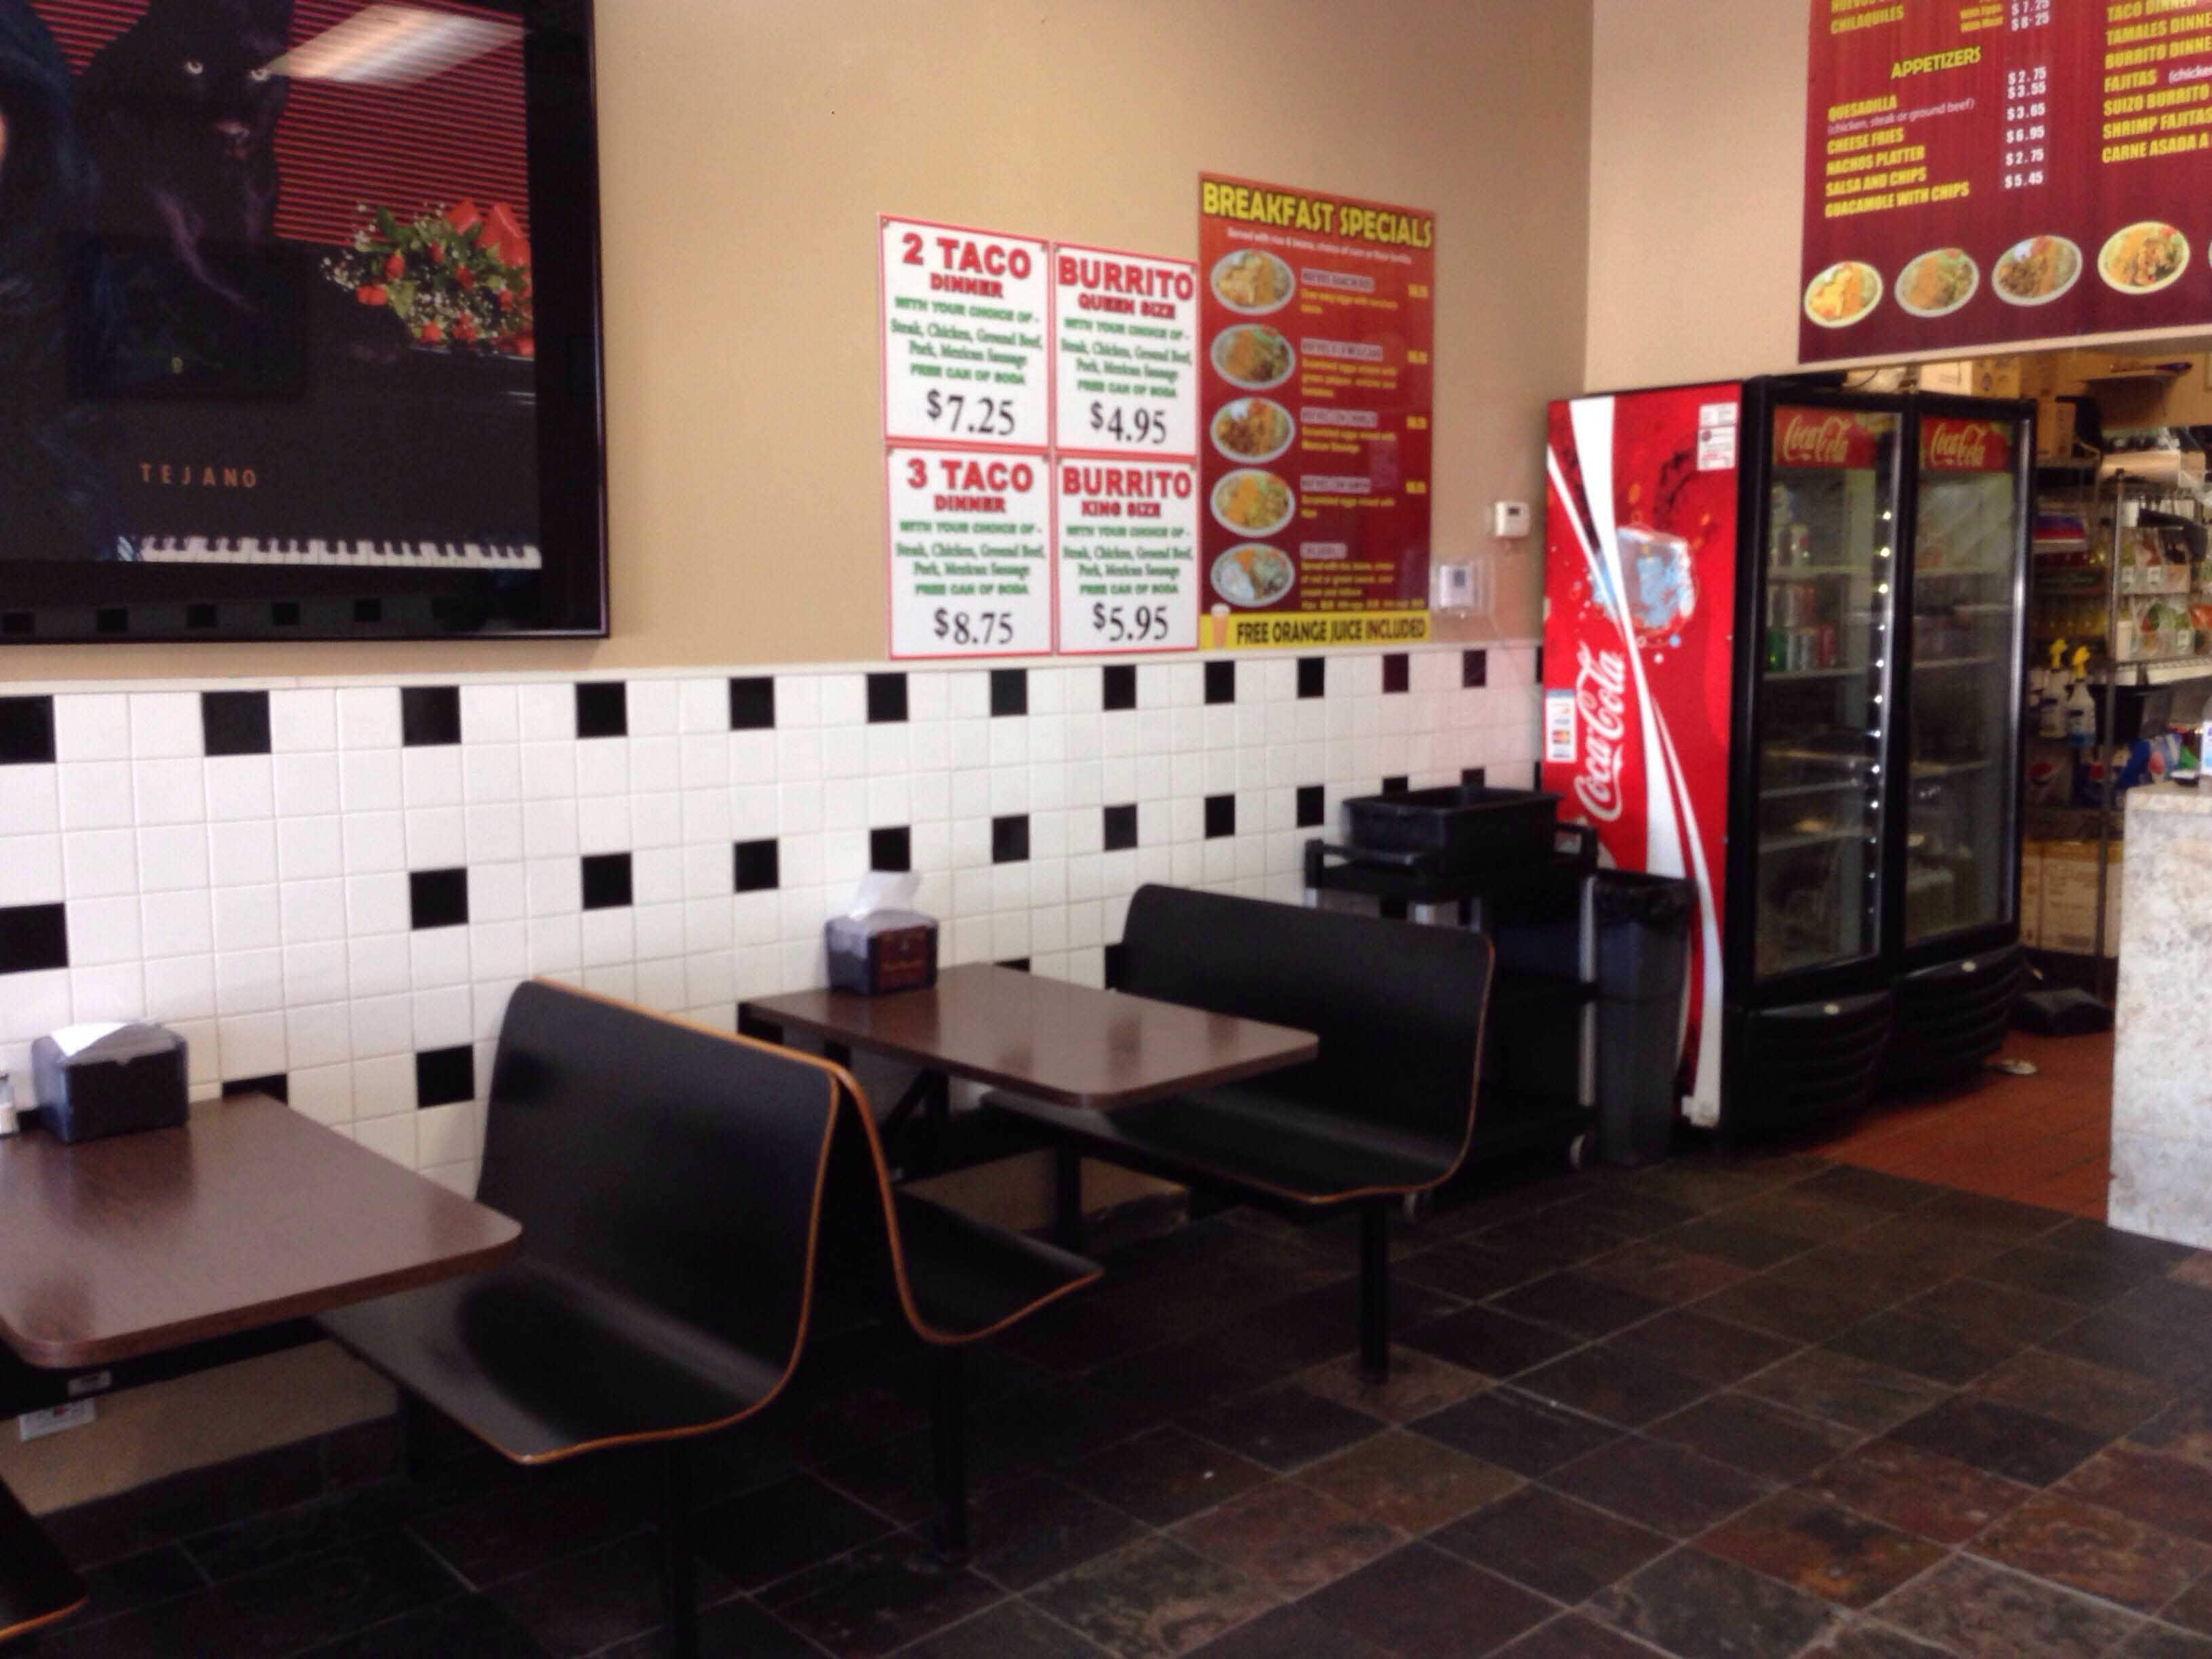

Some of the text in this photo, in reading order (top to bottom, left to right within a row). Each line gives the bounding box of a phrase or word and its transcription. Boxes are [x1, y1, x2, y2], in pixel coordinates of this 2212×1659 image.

[2106, 2, 2143, 23] TACO
[2105, 20, 2167, 47] TAMALES
[1891, 46, 1982, 79] APPETIZERS
[2104, 43, 2167, 70] BURRITO
[2104, 68, 2157, 94] FAJITAS
[1828, 95, 1897, 123] QUESADILLA
[2103, 83, 2210, 117] SUIZO BURRITO
[1826, 126, 1905, 155] CHEESE FRIES
[2103, 115, 2158, 140] SHRIMP
[1826, 144, 1926, 176] NACHOS PLATTER
[2102, 140, 2148, 163] CARNE
[2148, 134, 2197, 157] ASADA
[1825, 166, 1927, 197] SALSA AND CHIPS
[1896, 187, 1929, 207] WITH
[1931, 180, 1970, 202] CHIPS
[1202, 180, 1334, 233] BREAKFAST
[1339, 205, 1432, 249] SPECIALS
[902, 232, 1031, 280] 2 TACO
[929, 272, 1003, 299] DINNER
[1057, 255, 1194, 301] BURRITO
[1078, 293, 1176, 320] QUEEN SIZE
[926, 388, 1016, 436] $7.25
[1090, 401, 1168, 444] $4.95
[140, 463, 257, 489] TEJANO
[906, 458, 1034, 493] 3 TACO
[1062, 466, 1191, 499] BURRITO
[933, 495, 1006, 514] DINNER
[1081, 500, 1162, 518] KING SIZE
[933, 607, 1014, 646] $8.75
[1092, 602, 1168, 643] $5.95
[1237, 617, 1427, 644] FREE ORANGE JUICE INCLUDED
